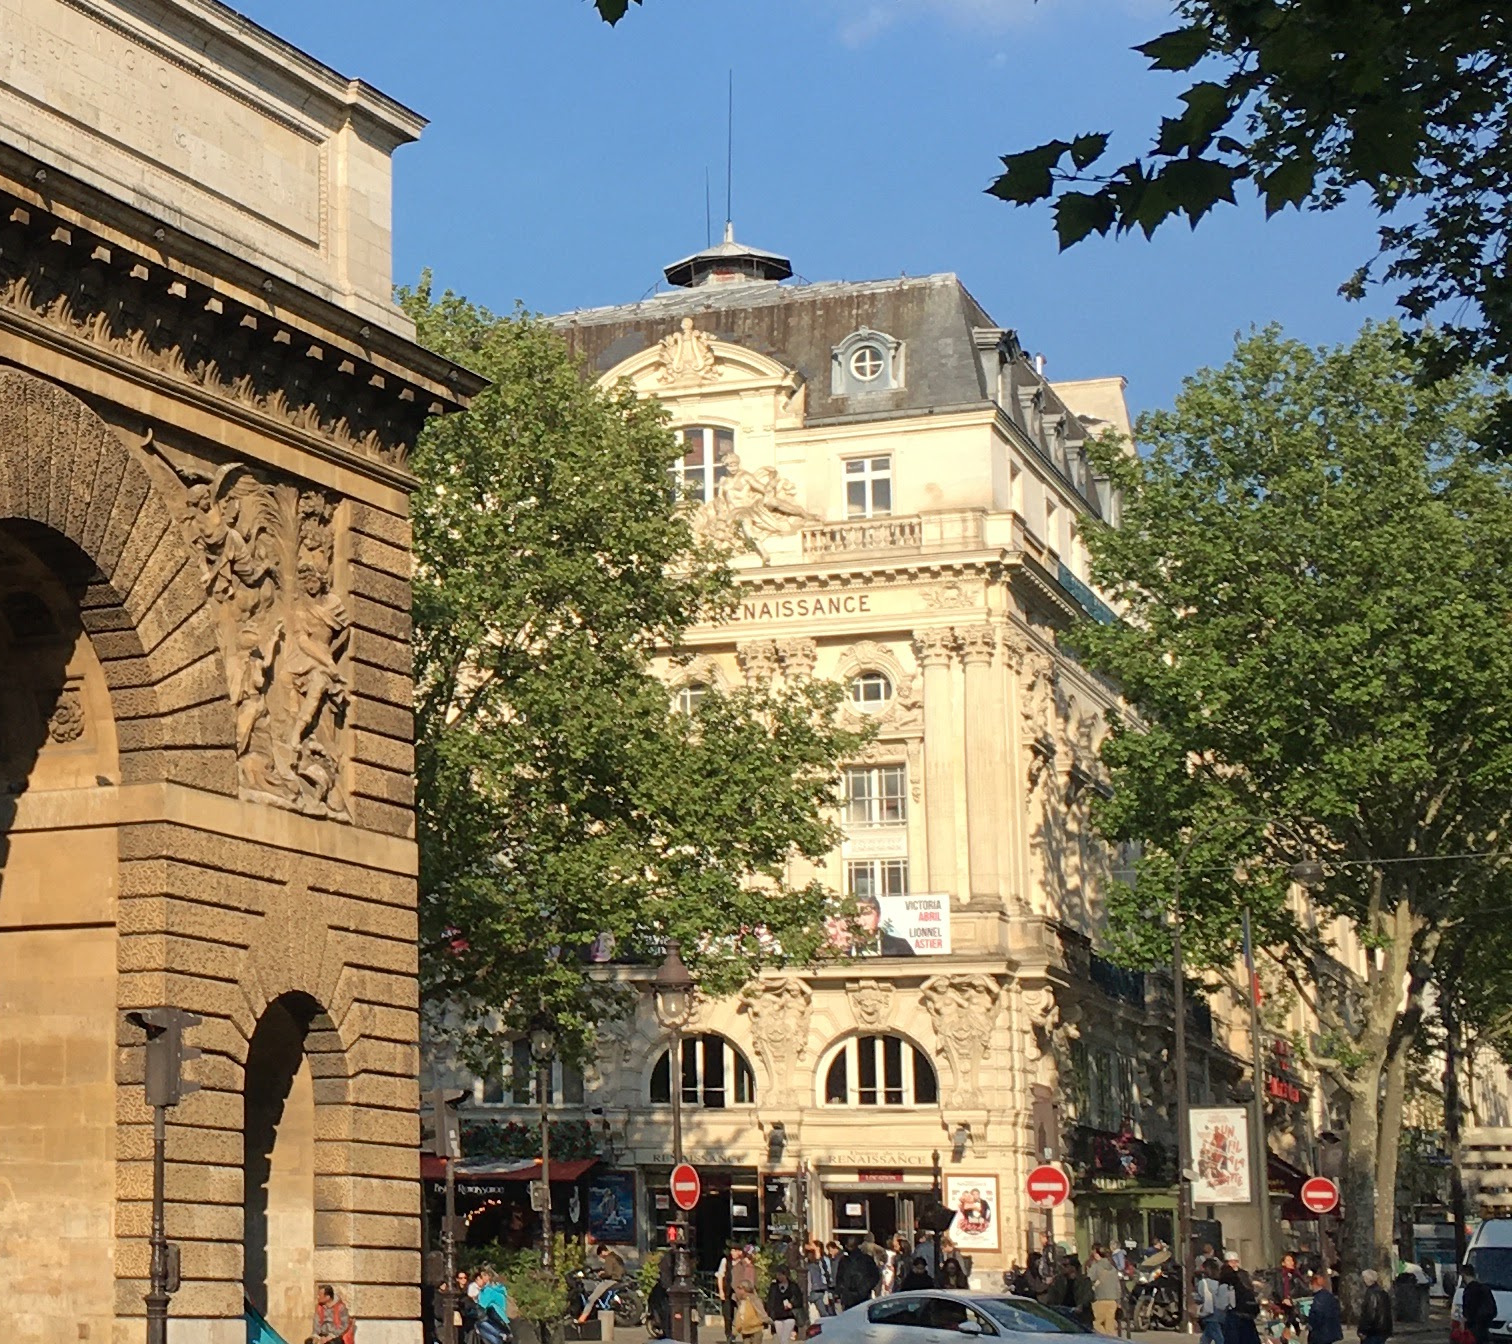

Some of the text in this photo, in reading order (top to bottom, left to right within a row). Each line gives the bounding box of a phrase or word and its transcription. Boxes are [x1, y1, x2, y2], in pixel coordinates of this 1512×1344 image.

[904, 900, 942, 910] VICTORIA
[918, 911, 942, 922] ABRIL
[909, 927, 942, 938] LIONNEL
[914, 939, 943, 949] ASTIER
[828, 1155, 926, 1165] RENAISSANCE
